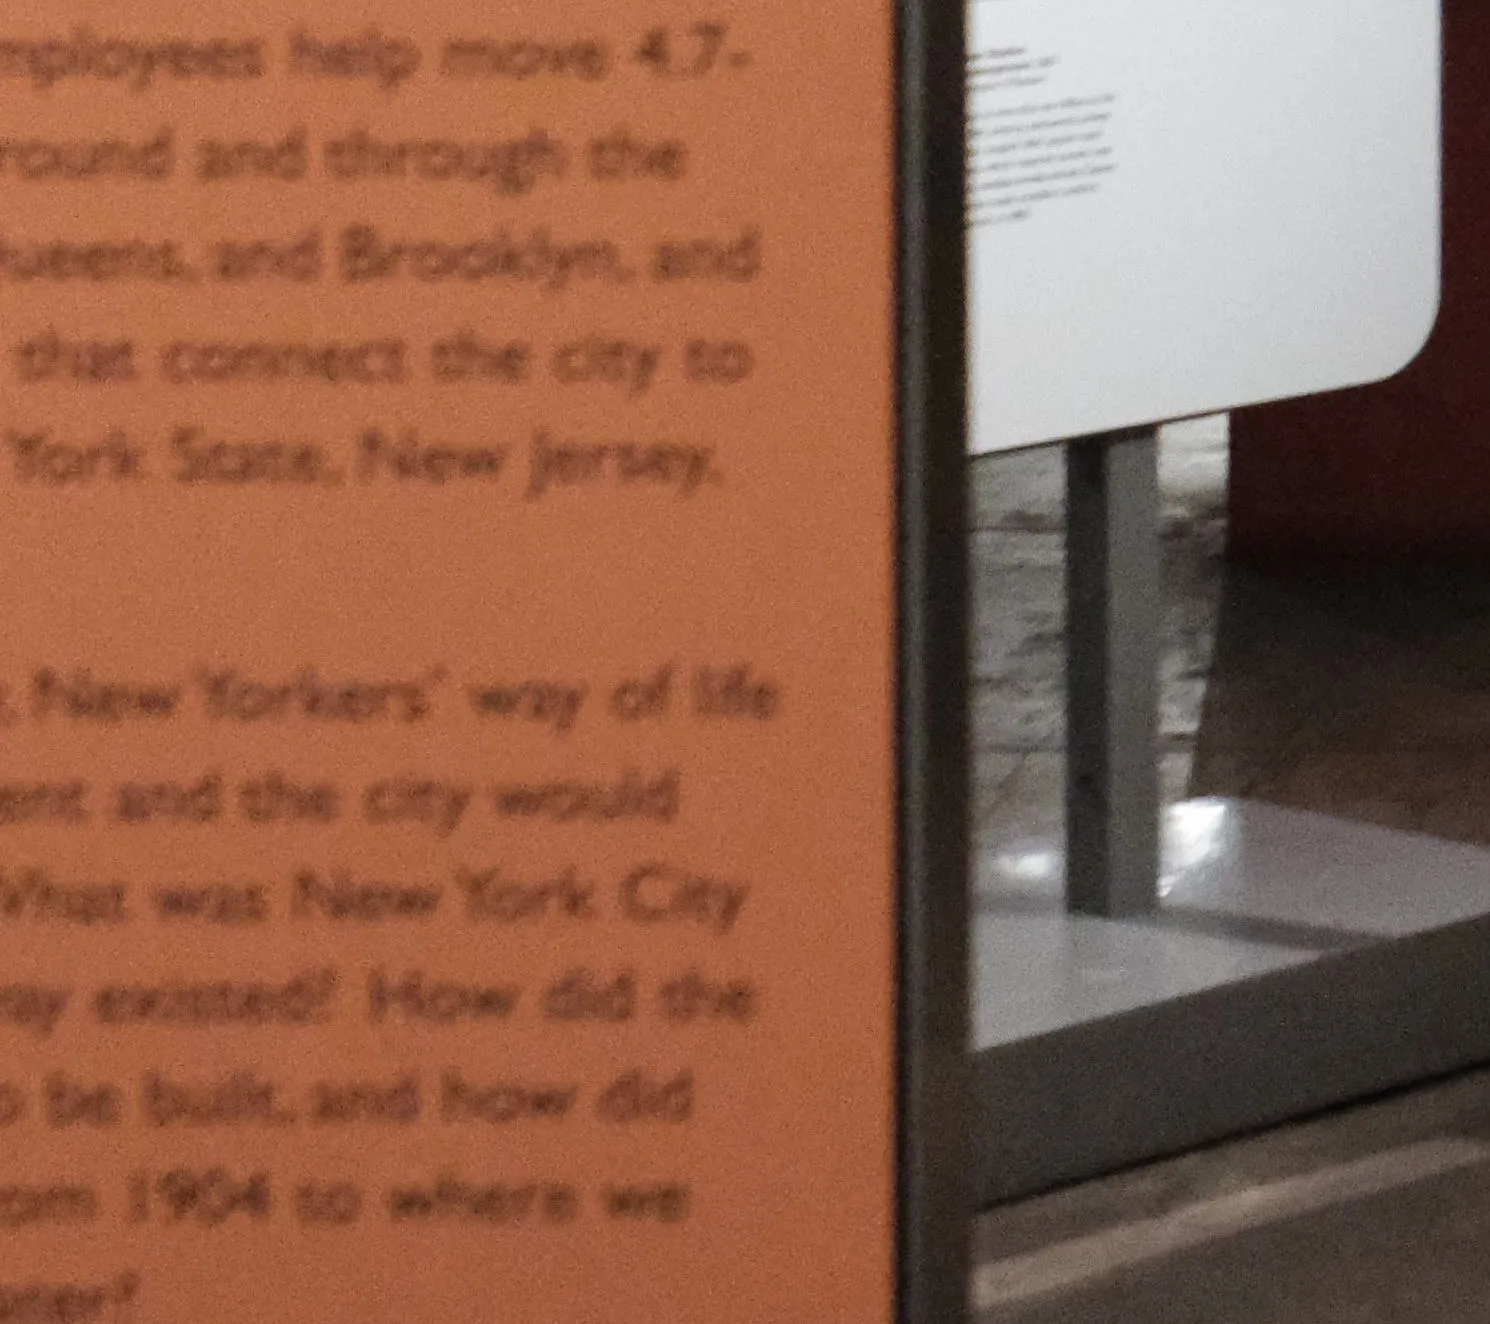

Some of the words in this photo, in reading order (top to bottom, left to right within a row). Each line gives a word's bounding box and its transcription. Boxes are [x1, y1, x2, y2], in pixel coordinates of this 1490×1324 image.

[196, 126, 307, 183] and
[586, 125, 689, 183] the
[0, 232, 198, 284] ueens,
[211, 226, 321, 284] and
[651, 224, 764, 284] and
[431, 329, 532, 385] the
[110, 771, 222, 825] and
[238, 768, 340, 825] the
[309, 1070, 421, 1129] and
